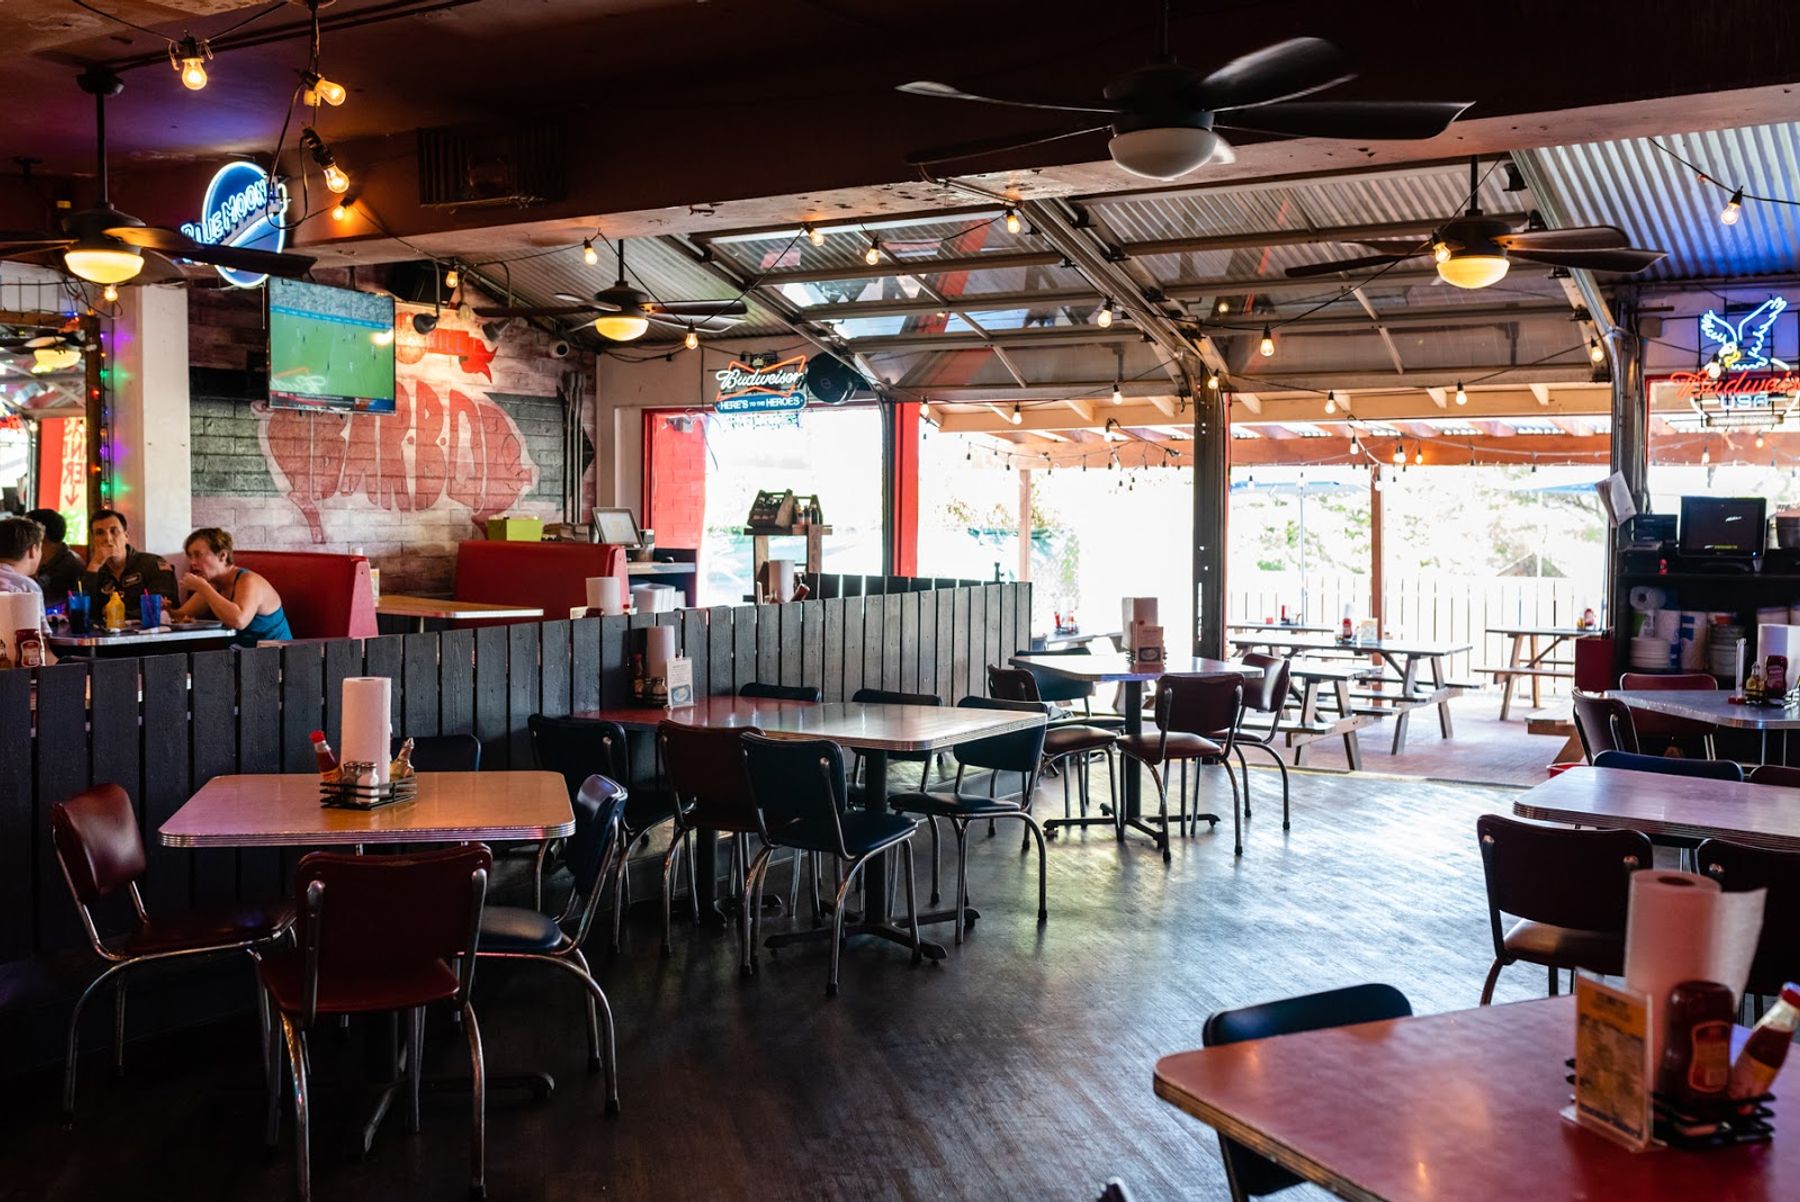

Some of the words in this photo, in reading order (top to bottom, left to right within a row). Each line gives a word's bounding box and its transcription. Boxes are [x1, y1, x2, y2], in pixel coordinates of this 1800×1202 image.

[715, 368, 804, 390] Budweiser
[720, 400, 749, 410] HERE'S
[766, 396, 800, 408] HEROES
[1720, 394, 1769, 410] USA
